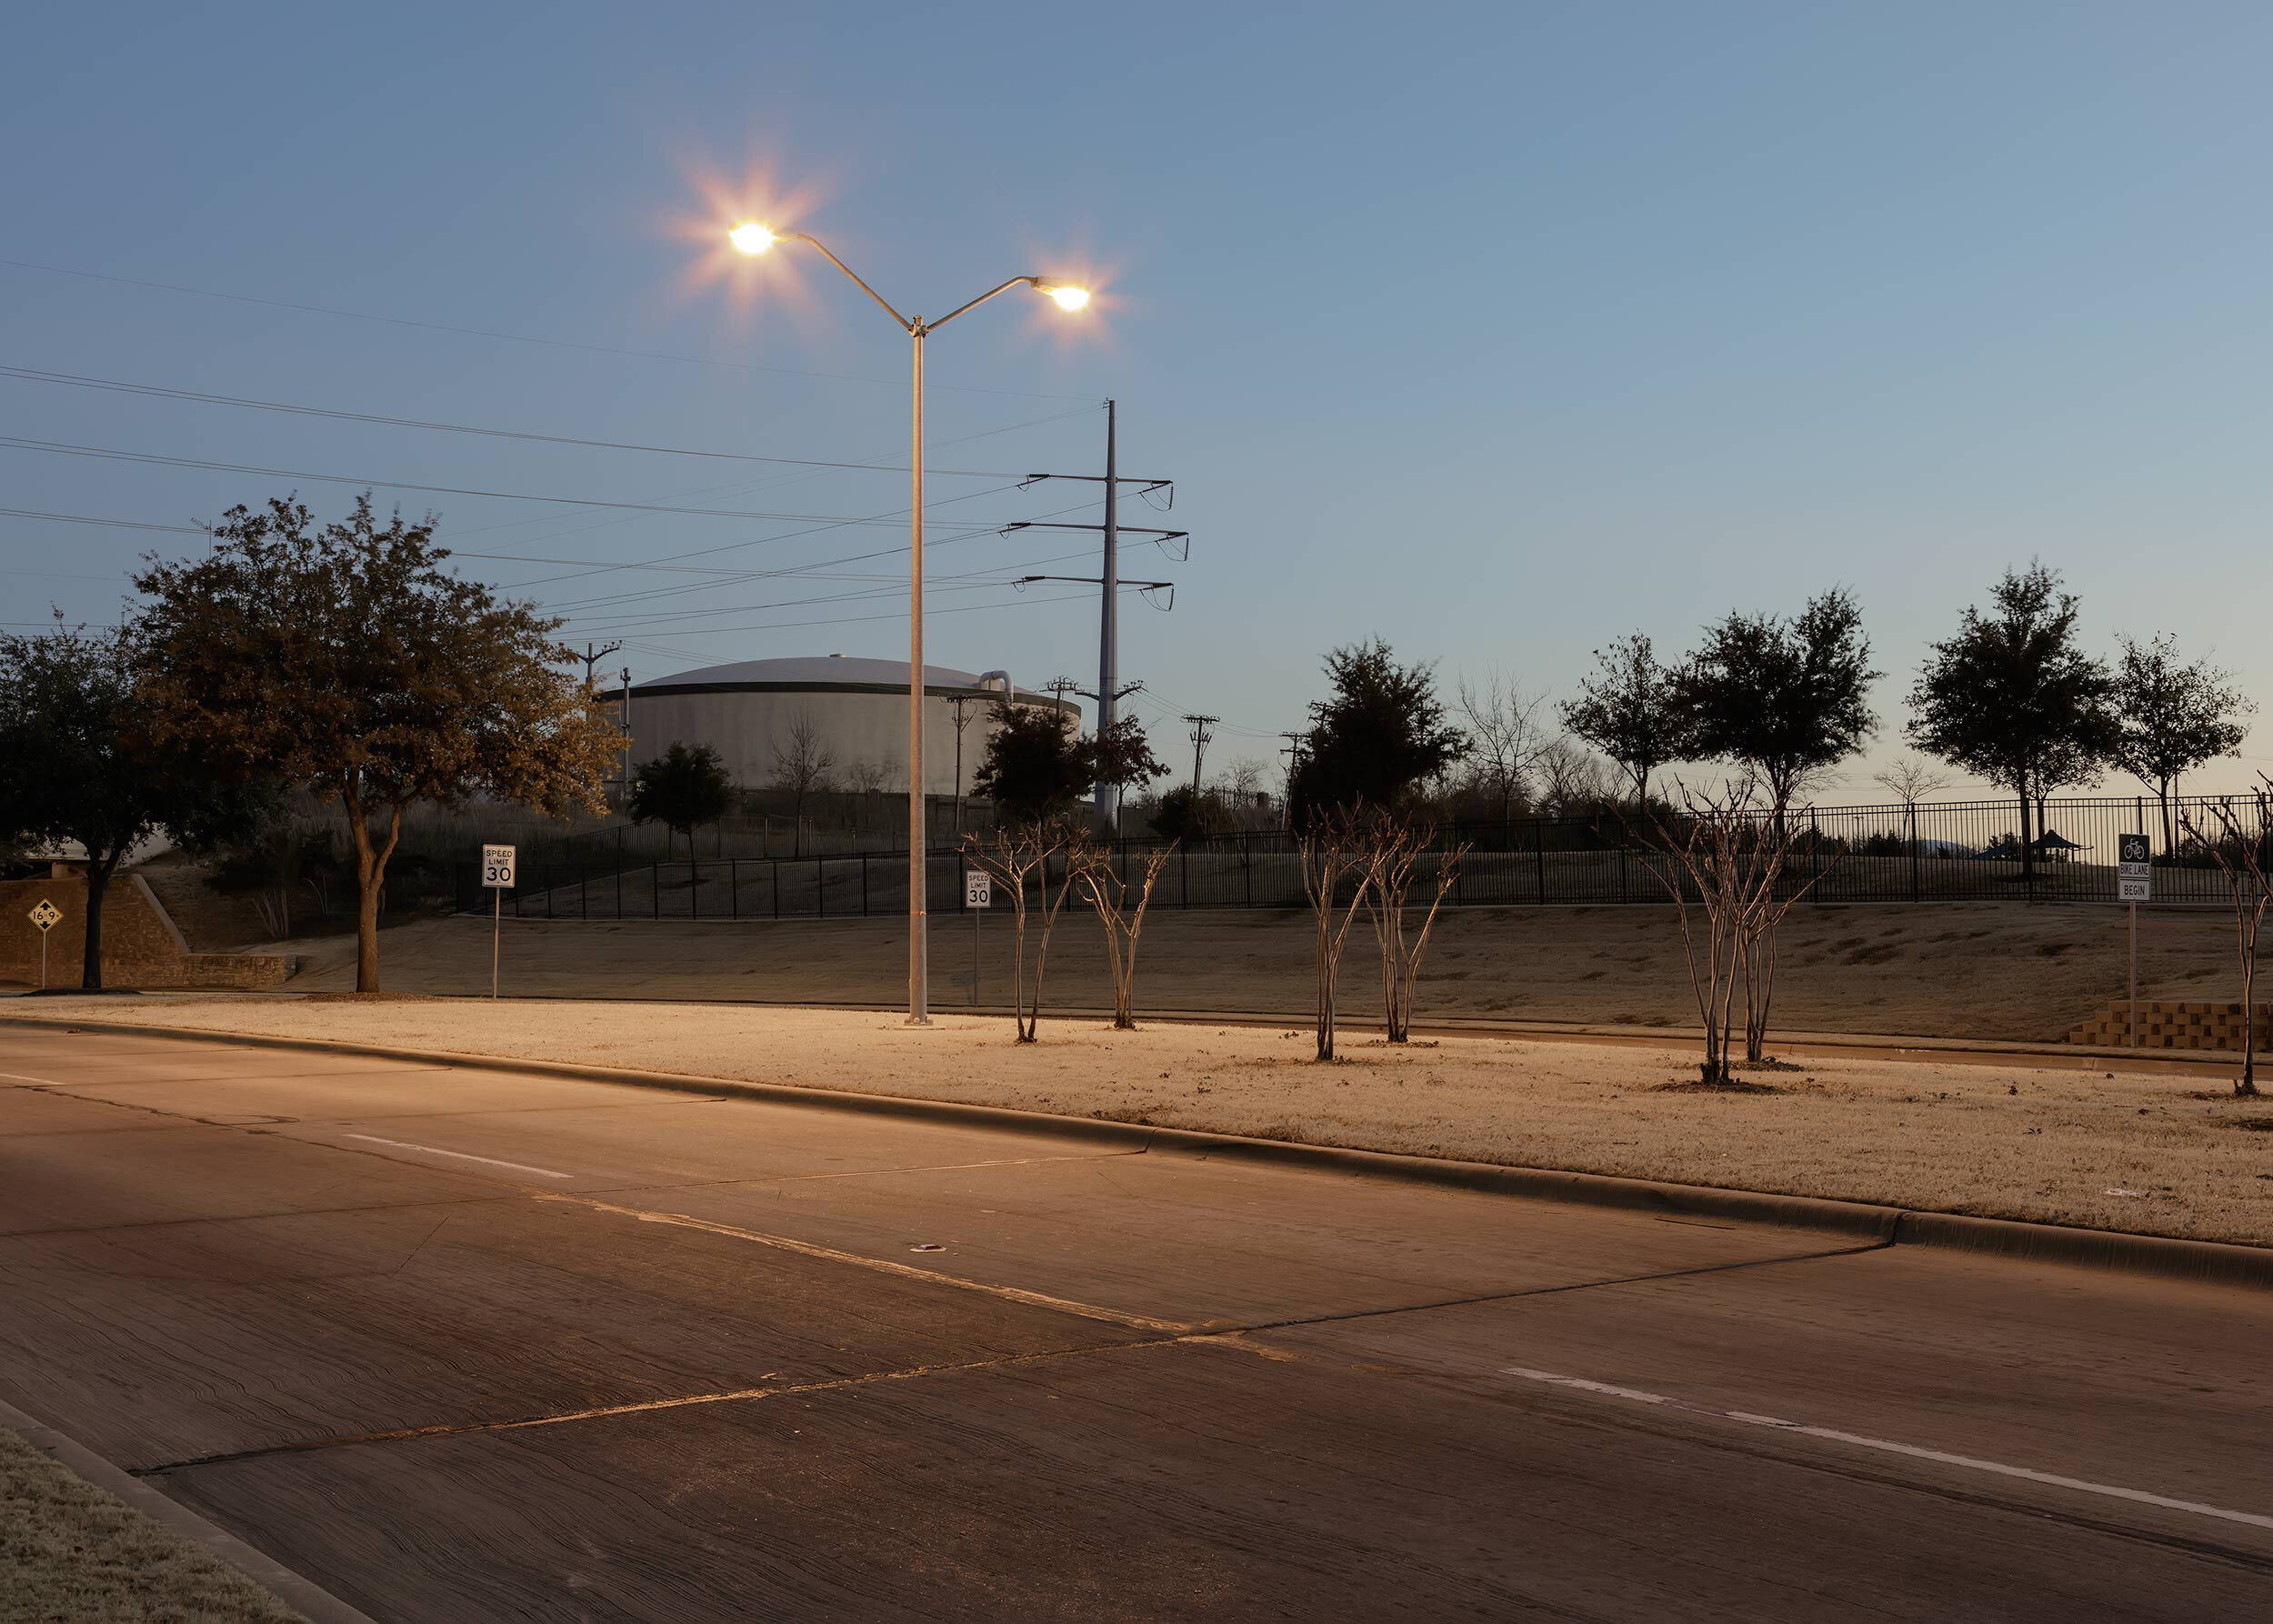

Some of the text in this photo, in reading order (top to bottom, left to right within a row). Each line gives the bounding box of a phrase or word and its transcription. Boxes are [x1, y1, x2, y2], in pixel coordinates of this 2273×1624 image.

[486, 867, 511, 881] 30
[2120, 863, 2148, 875] BIKE LANE
[969, 889, 988, 903] 30
[2124, 885, 2146, 896] BEGIN
